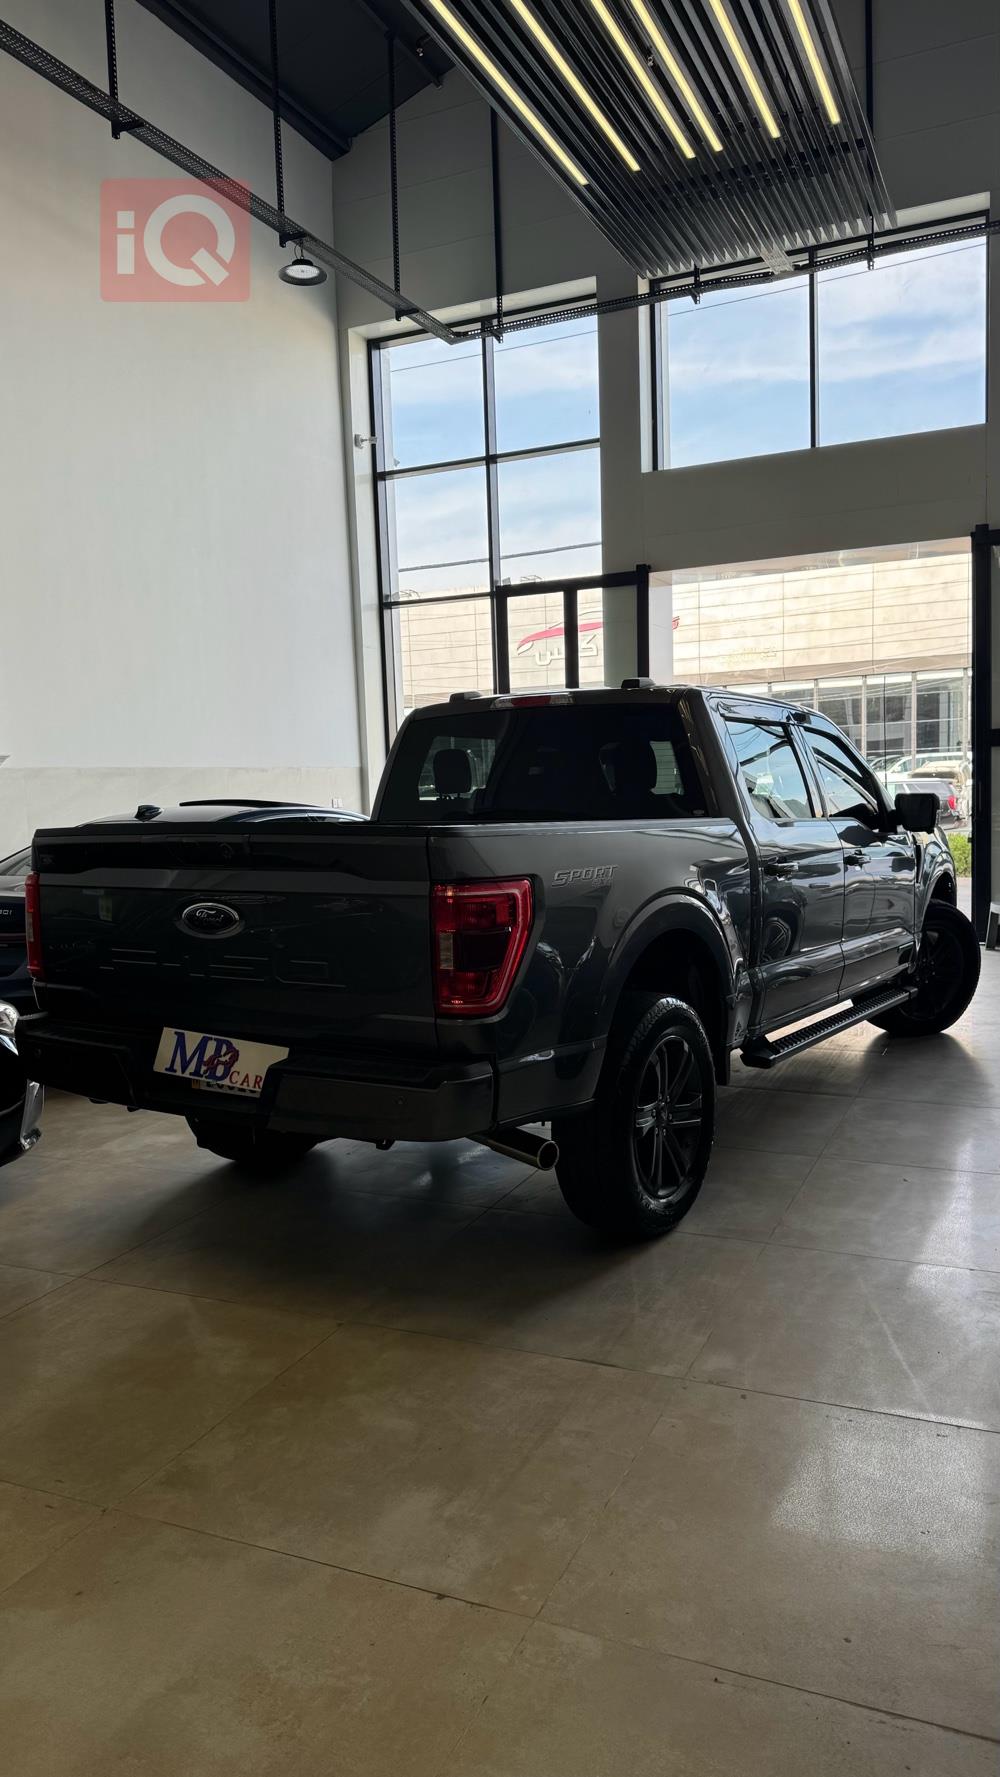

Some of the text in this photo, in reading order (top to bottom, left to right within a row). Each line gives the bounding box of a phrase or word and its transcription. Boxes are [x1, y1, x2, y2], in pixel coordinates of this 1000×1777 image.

[551, 865, 618, 888] SPORT
[165, 1031, 263, 1089] MB CAR
